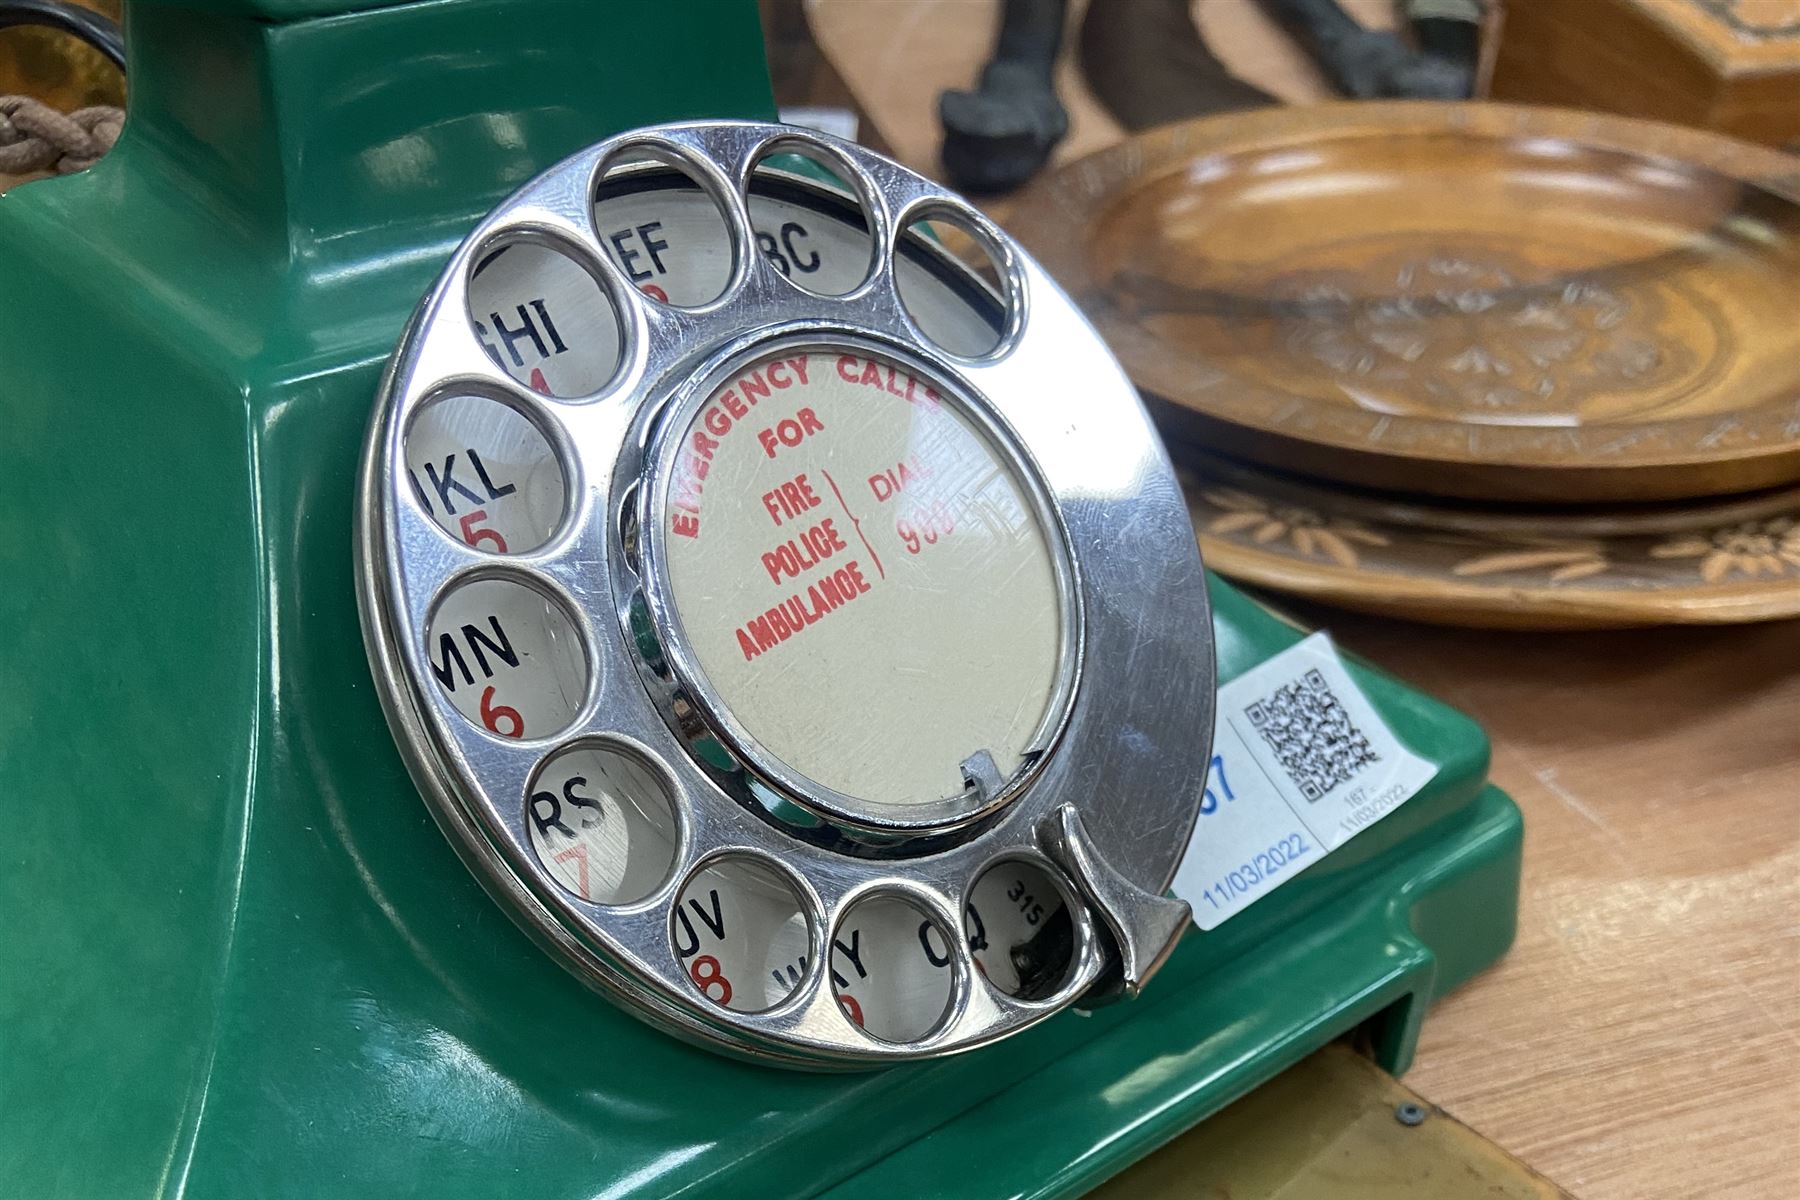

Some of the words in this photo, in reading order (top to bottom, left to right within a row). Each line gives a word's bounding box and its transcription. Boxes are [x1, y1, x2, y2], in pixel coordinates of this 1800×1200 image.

[610, 222, 668, 282] EF
[672, 354, 809, 539] EMERGENCY
[757, 407, 825, 459] FOR
[762, 473, 822, 526] FIRE
[867, 454, 935, 502] DIAL
[460, 510, 508, 553] 5
[761, 518, 848, 585] POLICE
[735, 560, 871, 661] AMBULANCE
[481, 686, 524, 738] 6
[530, 776, 606, 850] RS
[554, 843, 590, 900] 7
[1203, 832, 1310, 909] 11/03/2022
[1007, 880, 1044, 926] 315
[691, 955, 732, 1006] 8
